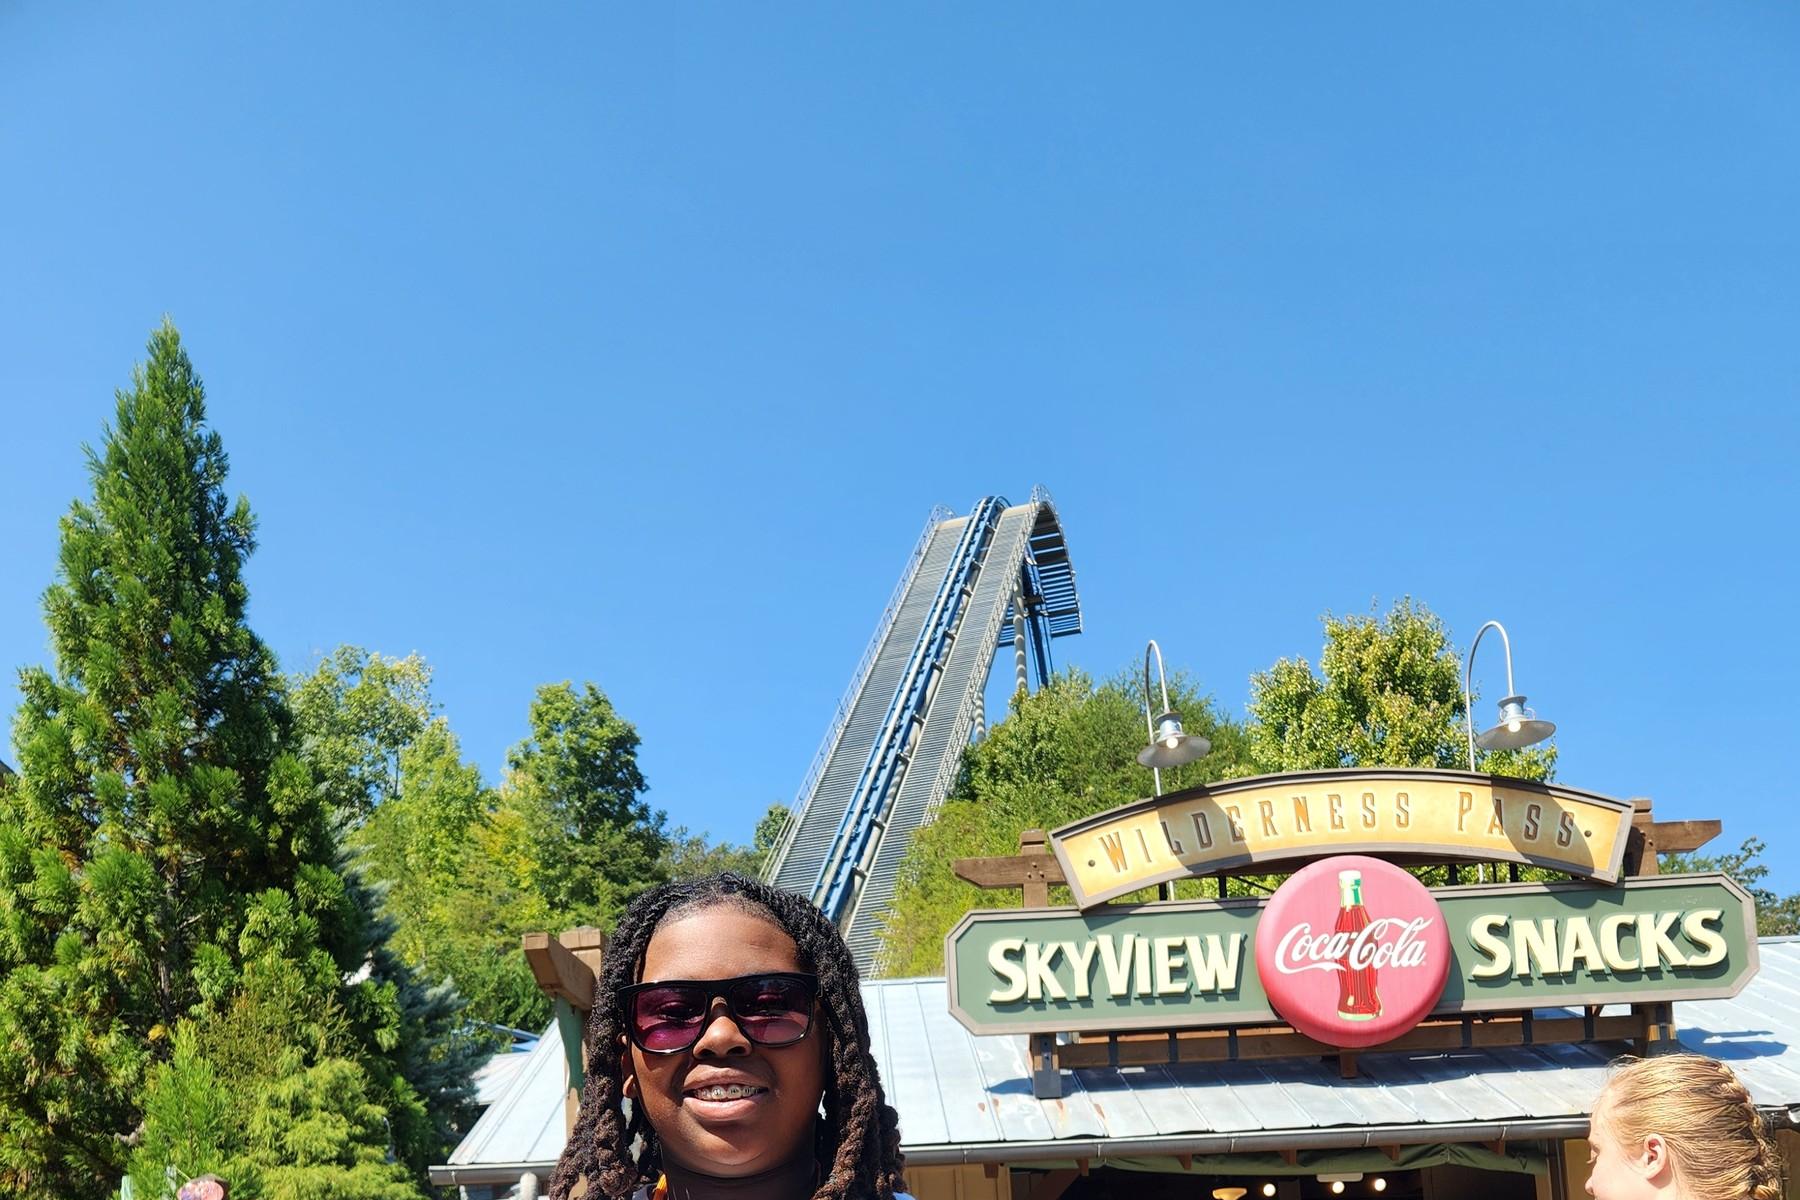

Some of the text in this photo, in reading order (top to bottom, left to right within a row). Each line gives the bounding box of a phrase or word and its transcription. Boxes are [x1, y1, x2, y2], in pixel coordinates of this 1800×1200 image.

[1098, 791, 1575, 874] WILDERNESS PASS
[987, 909, 1728, 1002] SKYVIEW SNACKS
[1274, 916, 1434, 975] Coca-Cola
